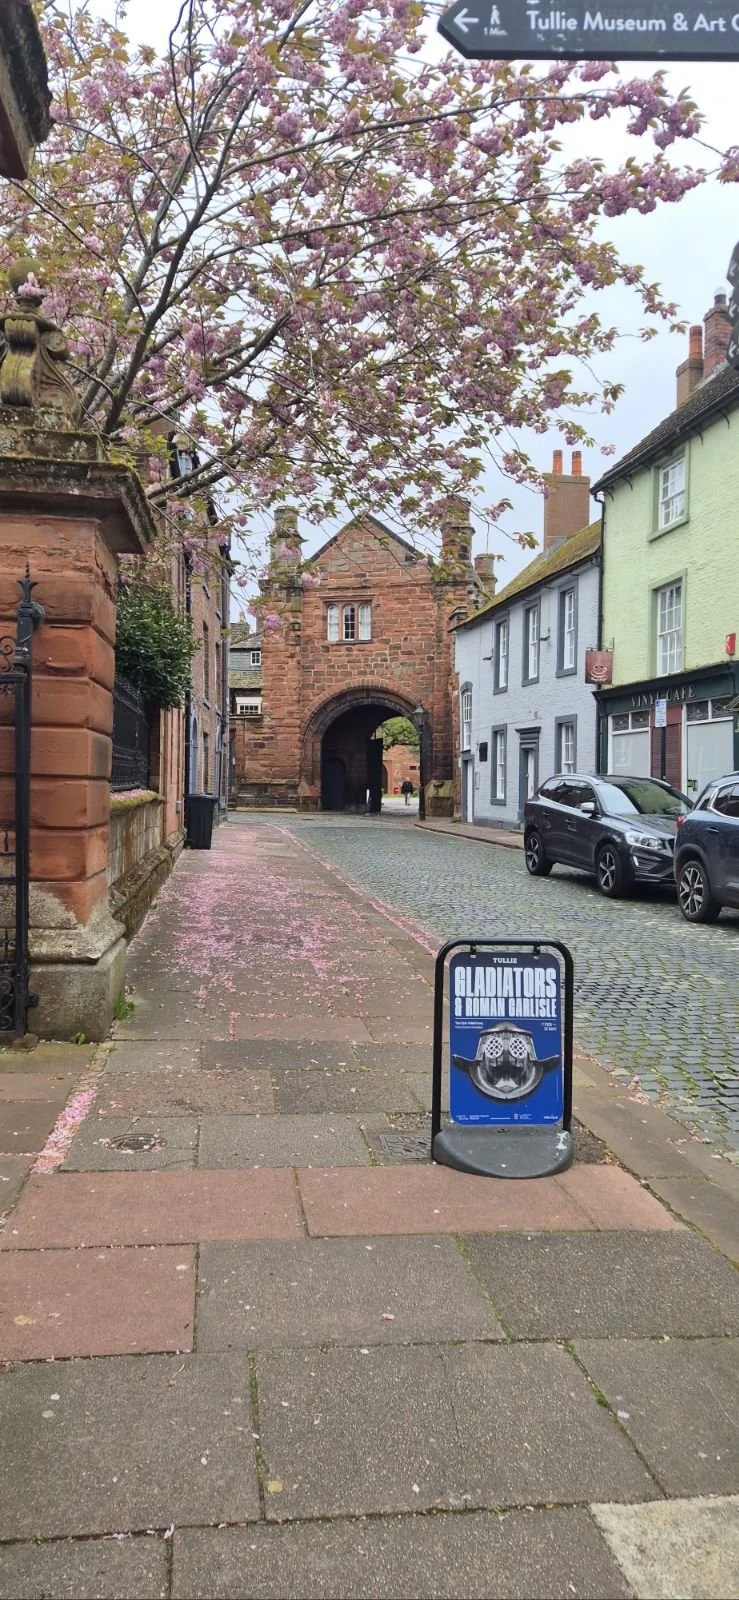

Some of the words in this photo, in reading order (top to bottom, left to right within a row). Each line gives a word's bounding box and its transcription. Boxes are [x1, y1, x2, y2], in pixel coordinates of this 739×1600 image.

[484, 28, 488, 36] 1
[526, 11, 578, 31] Tullie
[583, 11, 666, 32] Museum
[672, 13, 688, 32] &
[693, 14, 726, 32] Art
[666, 685, 695, 701] CAFE
[454, 966, 557, 998] GLADIATORS
[455, 997, 462, 1017] &
[465, 998, 505, 1017] ROMAN
[508, 998, 557, 1018] CARLISLE
